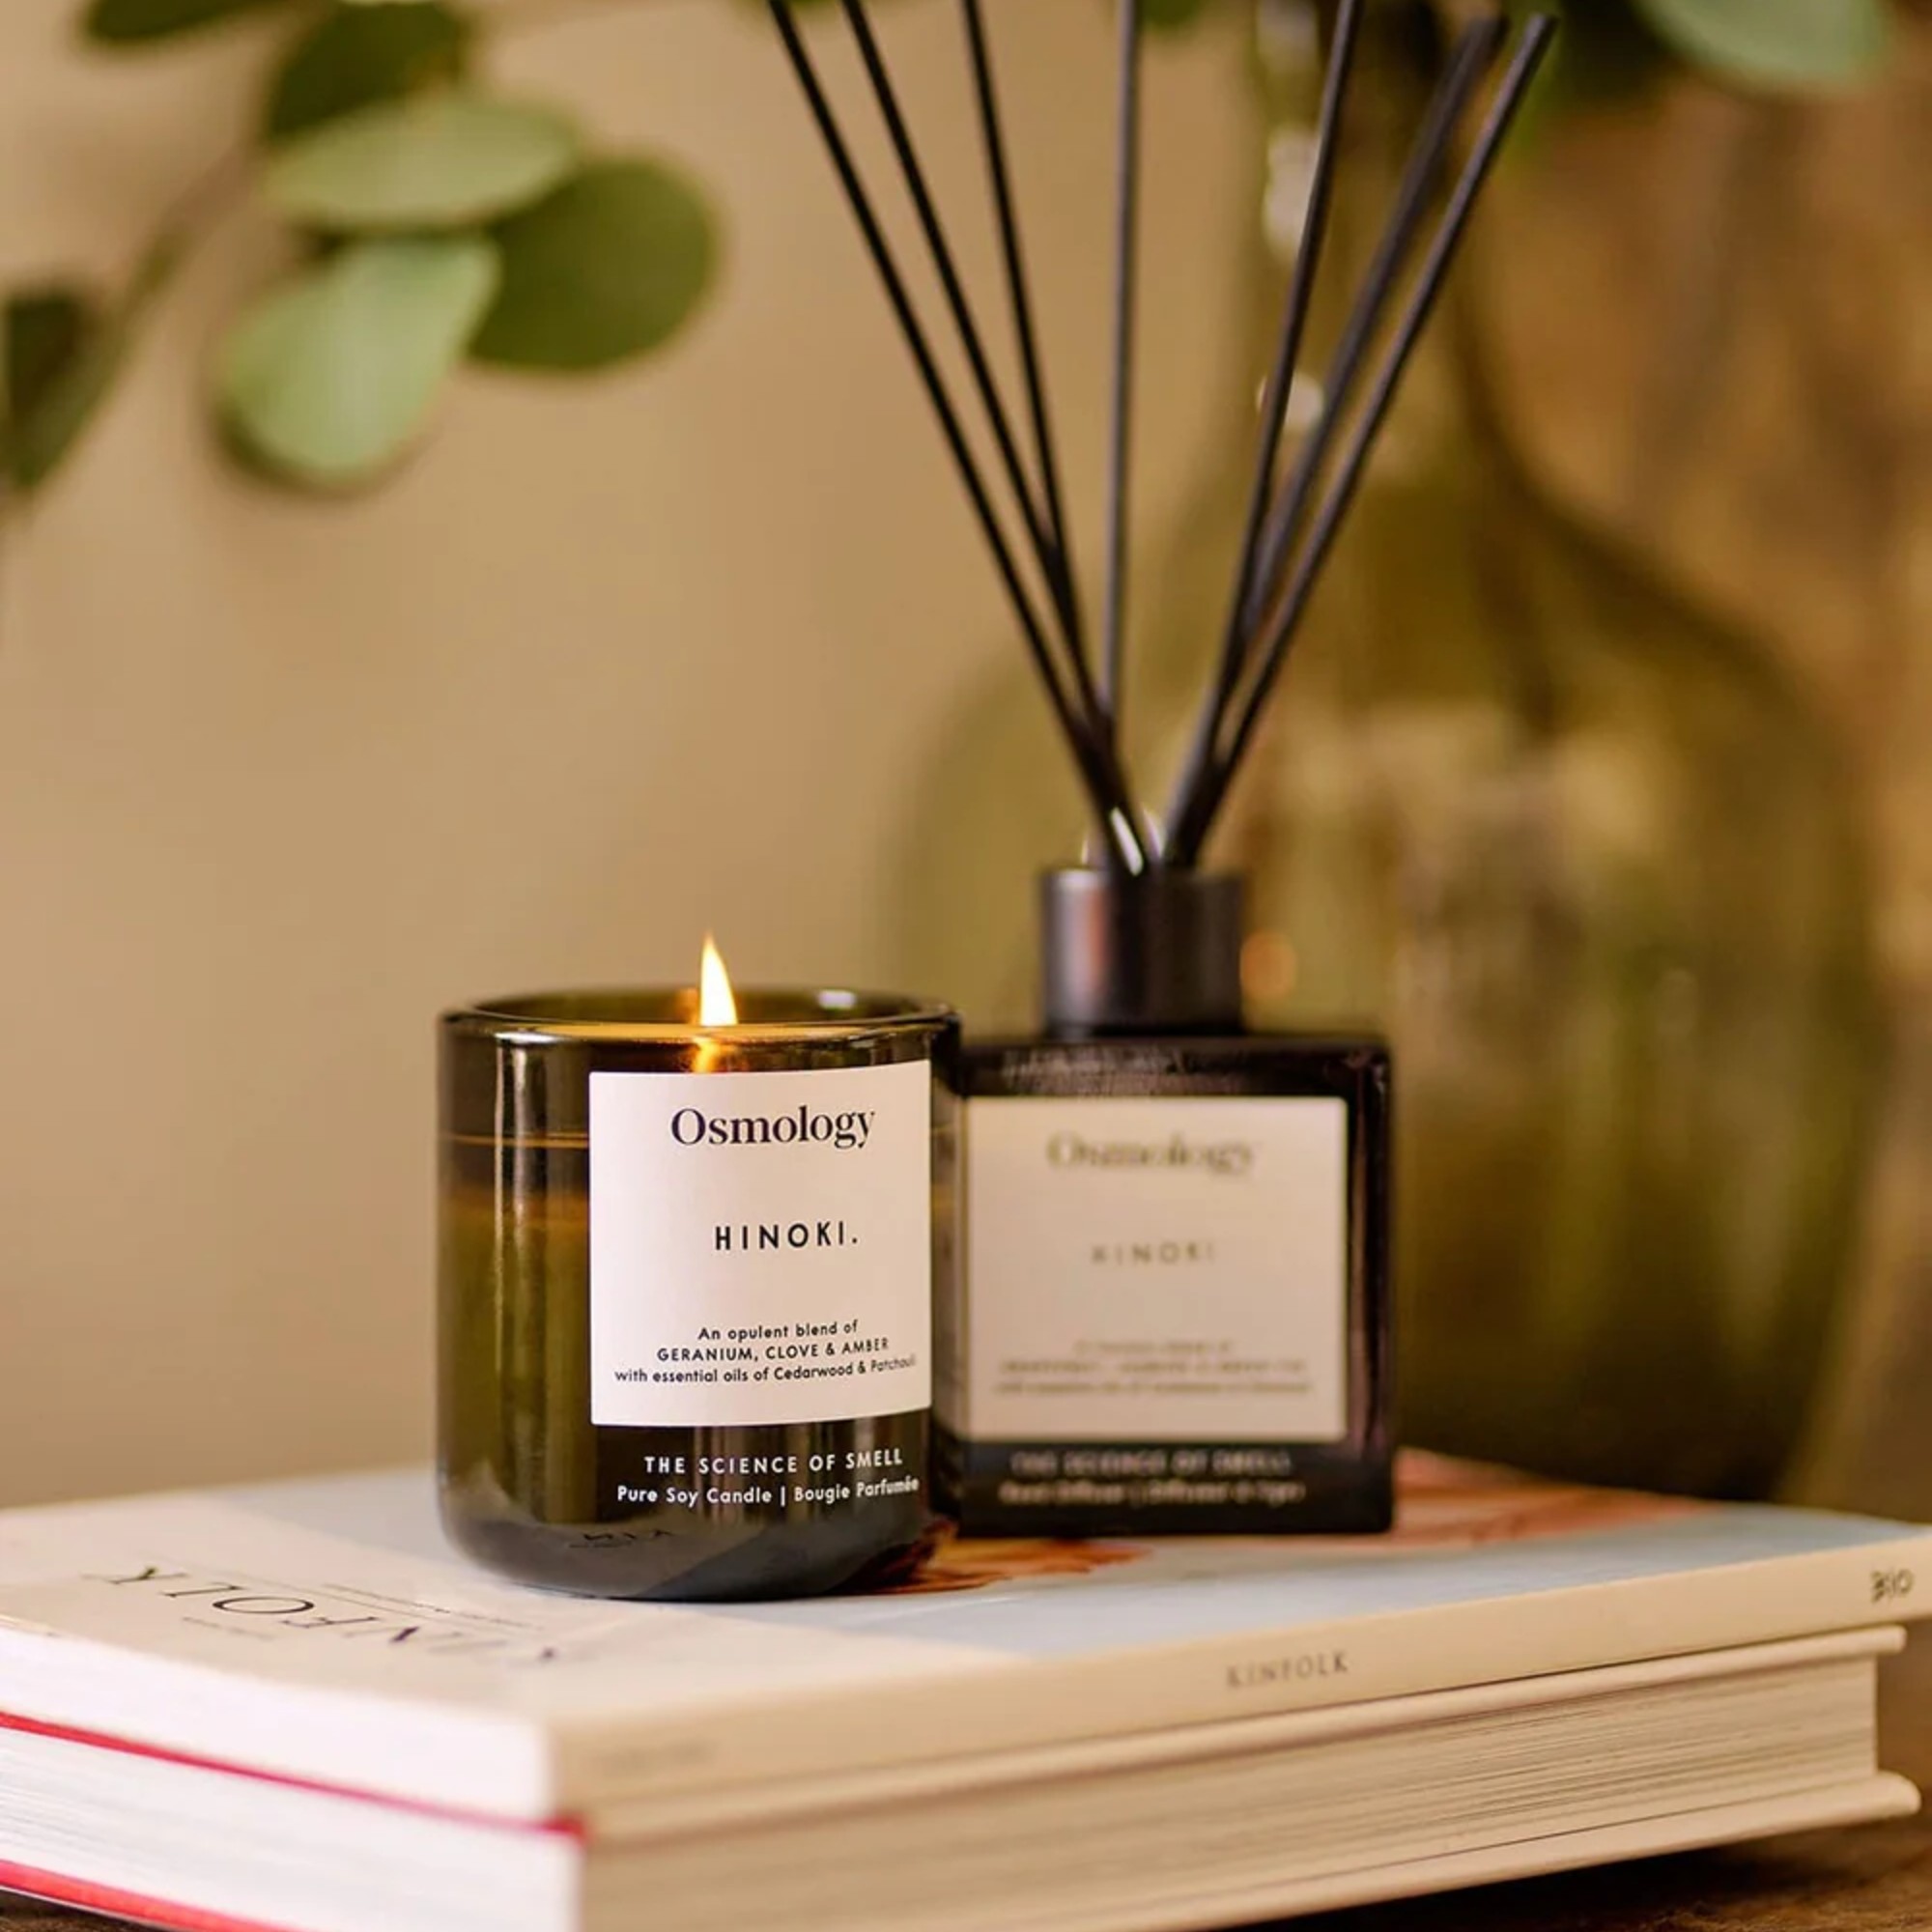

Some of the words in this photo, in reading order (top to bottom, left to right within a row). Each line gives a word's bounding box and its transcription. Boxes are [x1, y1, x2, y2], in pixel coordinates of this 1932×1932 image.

[671, 1105, 876, 1150] Osmology
[715, 1220, 859, 1251] HINOKI.
[697, 1326, 721, 1340] An
[727, 1324, 788, 1343] opulent
[796, 1321, 838, 1337] blend
[843, 1319, 858, 1334] of
[657, 1347, 758, 1362] GERANIUM,
[765, 1344, 818, 1360] CLOVE
[825, 1342, 836, 1356] &
[841, 1337, 889, 1354] AMBER
[614, 1368, 648, 1382] with
[652, 1368, 718, 1382] essential
[723, 1367, 749, 1382] oils
[753, 1366, 770, 1381] of
[774, 1361, 853, 1380] Cedarwood
[857, 1360, 867, 1375] &
[644, 1456, 686, 1474] THE
[698, 1457, 797, 1475] SCIENCE
[809, 1454, 836, 1472] OF
[845, 1448, 903, 1469] SMELL
[617, 1485, 658, 1501] Pure
[666, 1487, 698, 1508] Soy
[706, 1487, 772, 1503] Candle
[794, 1484, 850, 1504] Bougie
